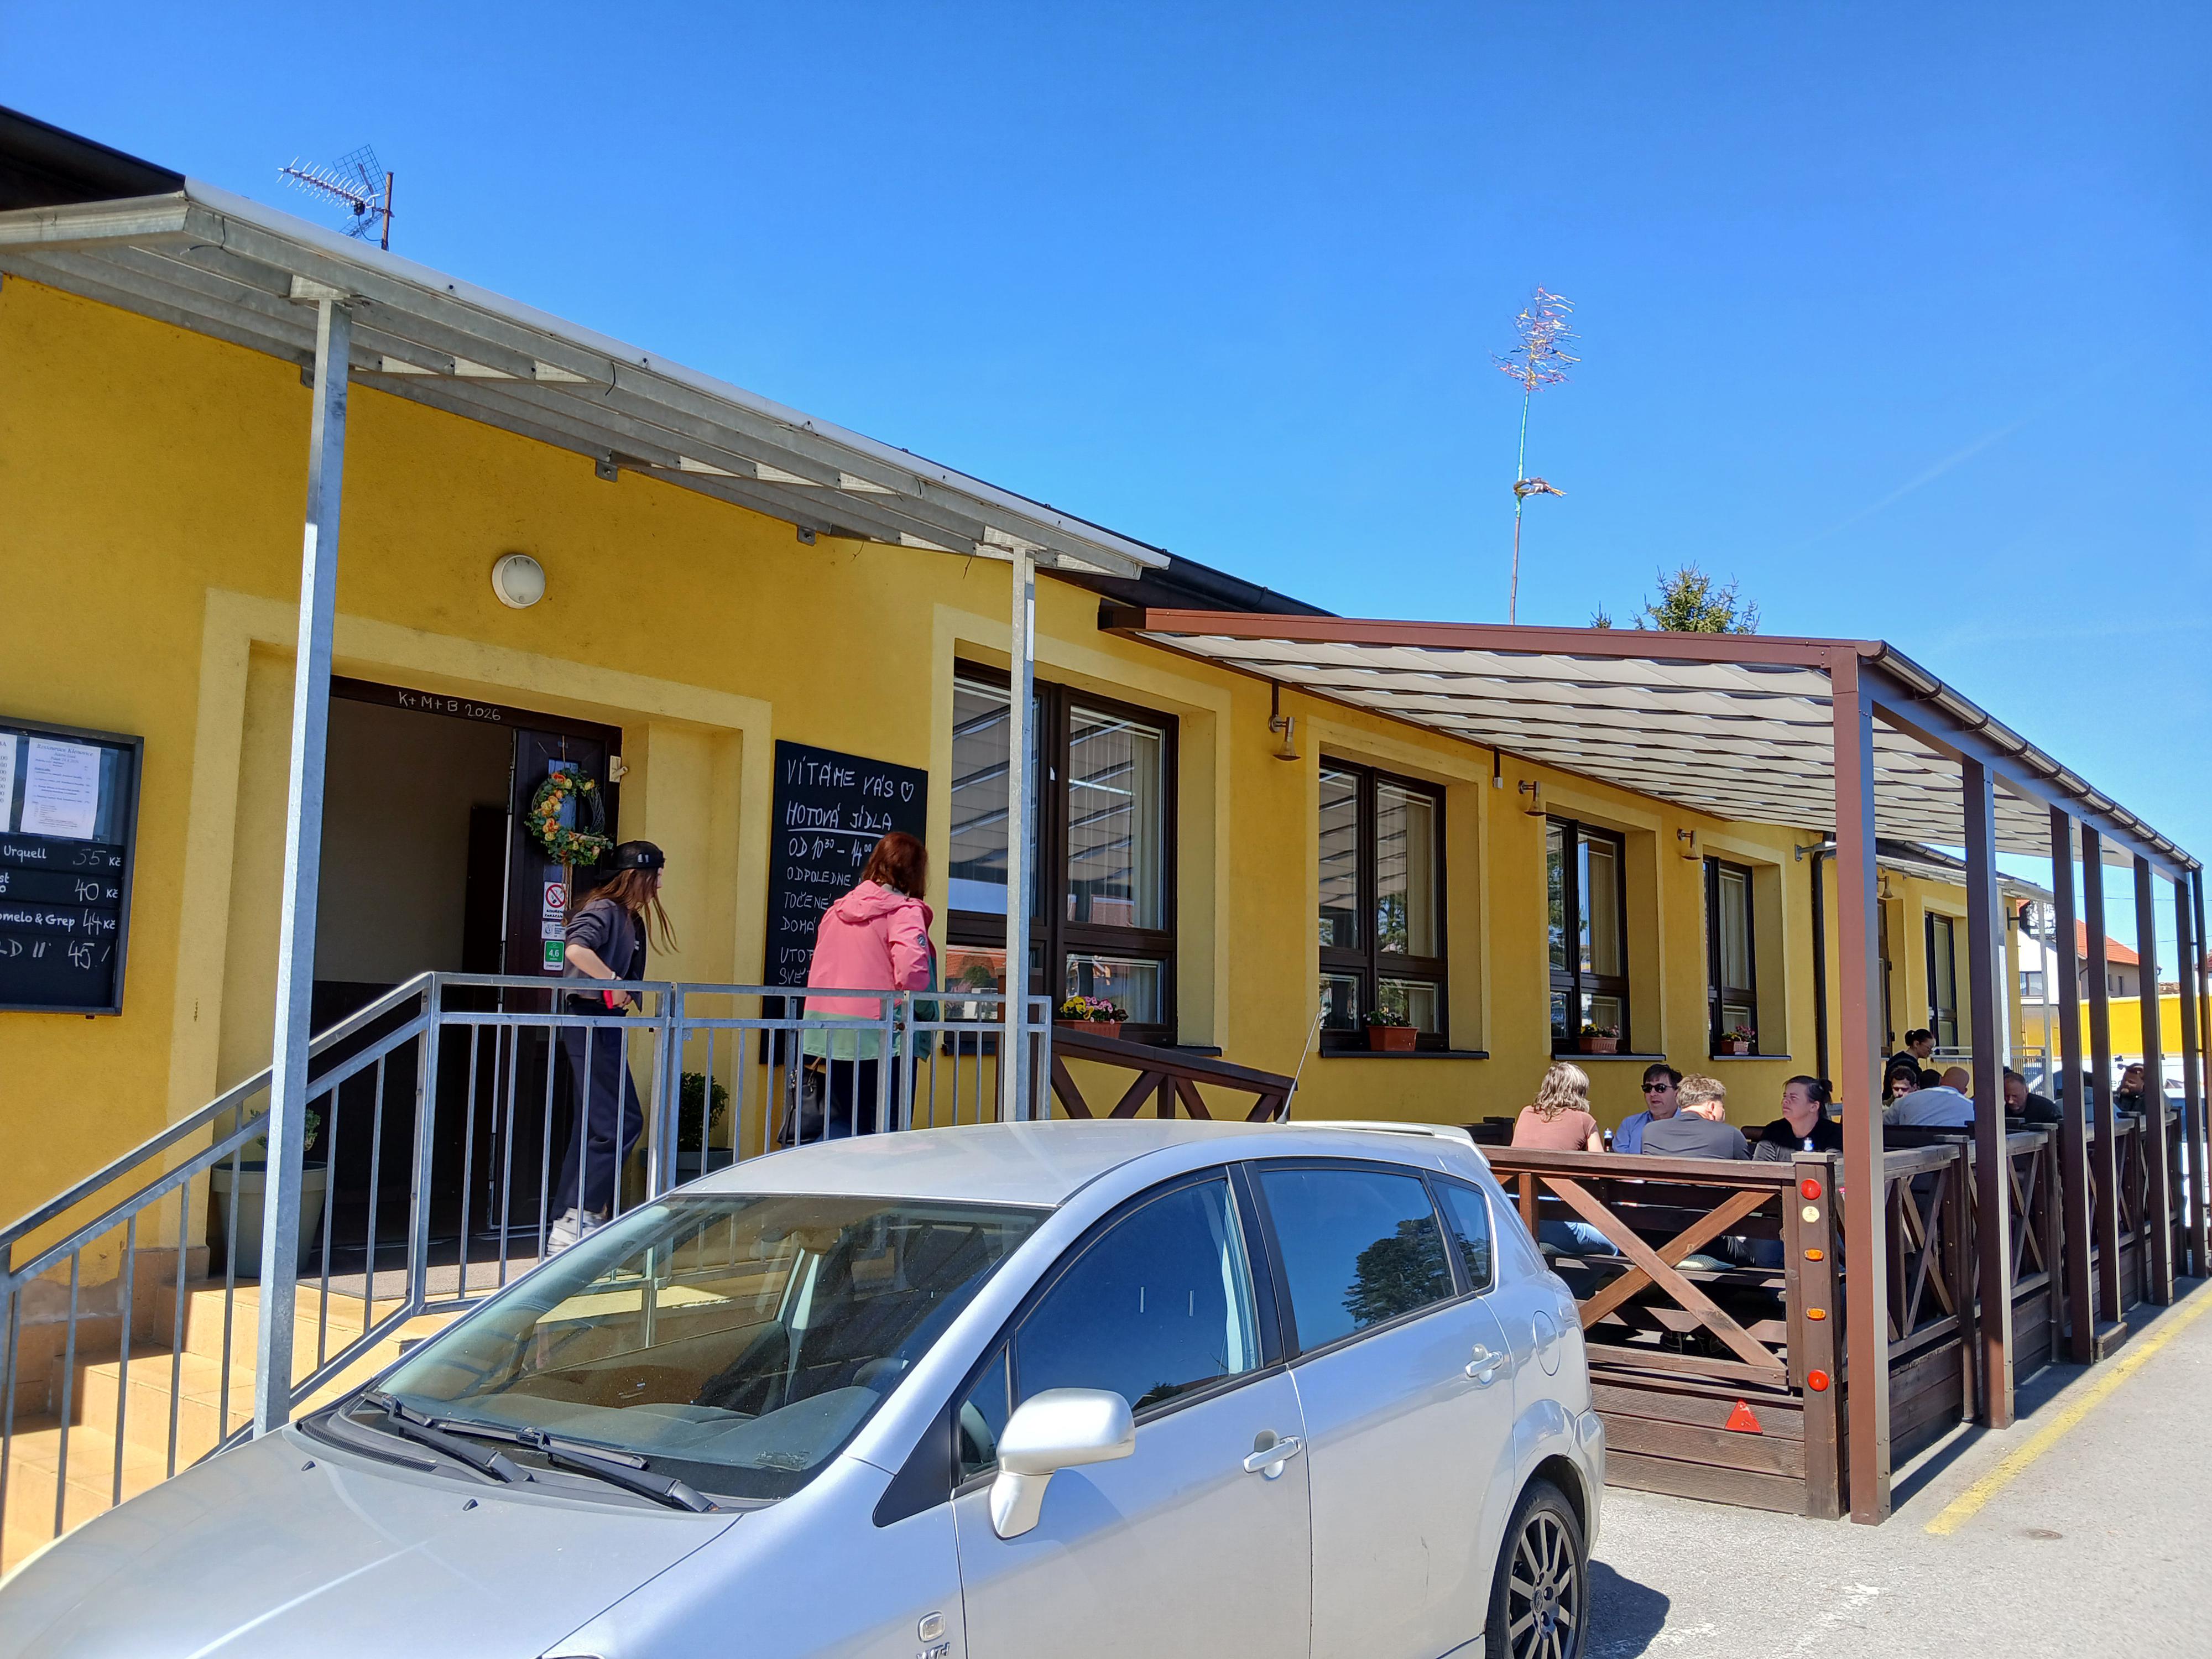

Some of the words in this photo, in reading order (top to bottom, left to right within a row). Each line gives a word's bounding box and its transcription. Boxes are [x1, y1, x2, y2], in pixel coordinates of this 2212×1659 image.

[465, 704, 501, 721] 2026
[787, 756, 855, 787] VÍTÁME
[863, 774, 894, 797] VÁS
[786, 800, 841, 828] HOTOVÁ
[849, 805, 892, 831] JÍDLA
[3, 845, 47, 863] Urquell
[109, 857, 122, 867] Kč
[789, 837, 808, 857] OD
[787, 867, 852, 886] ODPOLEDNE
[75, 878, 100, 901] 40
[106, 889, 118, 898] Kč
[784, 891, 832, 910] TOČENÉ
[35, 913, 43, 925] &
[45, 914, 75, 932] Grep
[83, 909, 102, 935] 44
[103, 920, 116, 930] Kč
[780, 916, 817, 935] DOMÁ
[780, 946, 814, 963] UTOP
